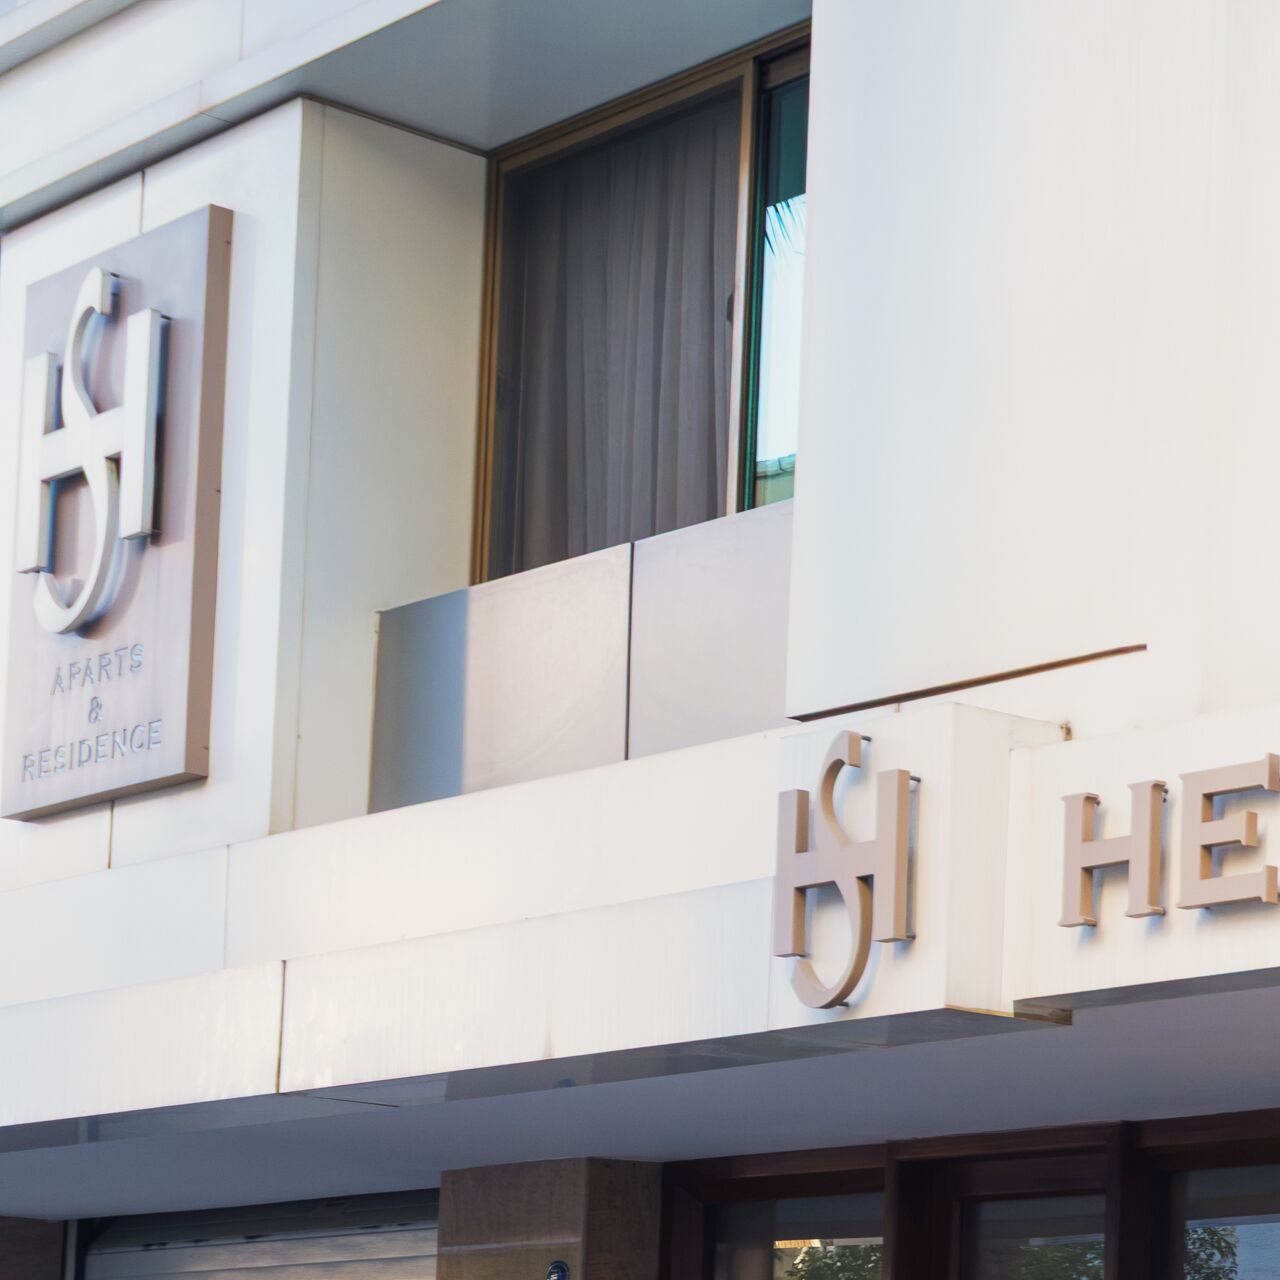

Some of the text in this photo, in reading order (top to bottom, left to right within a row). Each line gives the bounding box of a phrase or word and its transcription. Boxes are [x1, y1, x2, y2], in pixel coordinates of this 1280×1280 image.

[51, 643, 144, 696] APARTS
[88, 696, 103, 724] &
[21, 718, 162, 783] RESIDENCE
